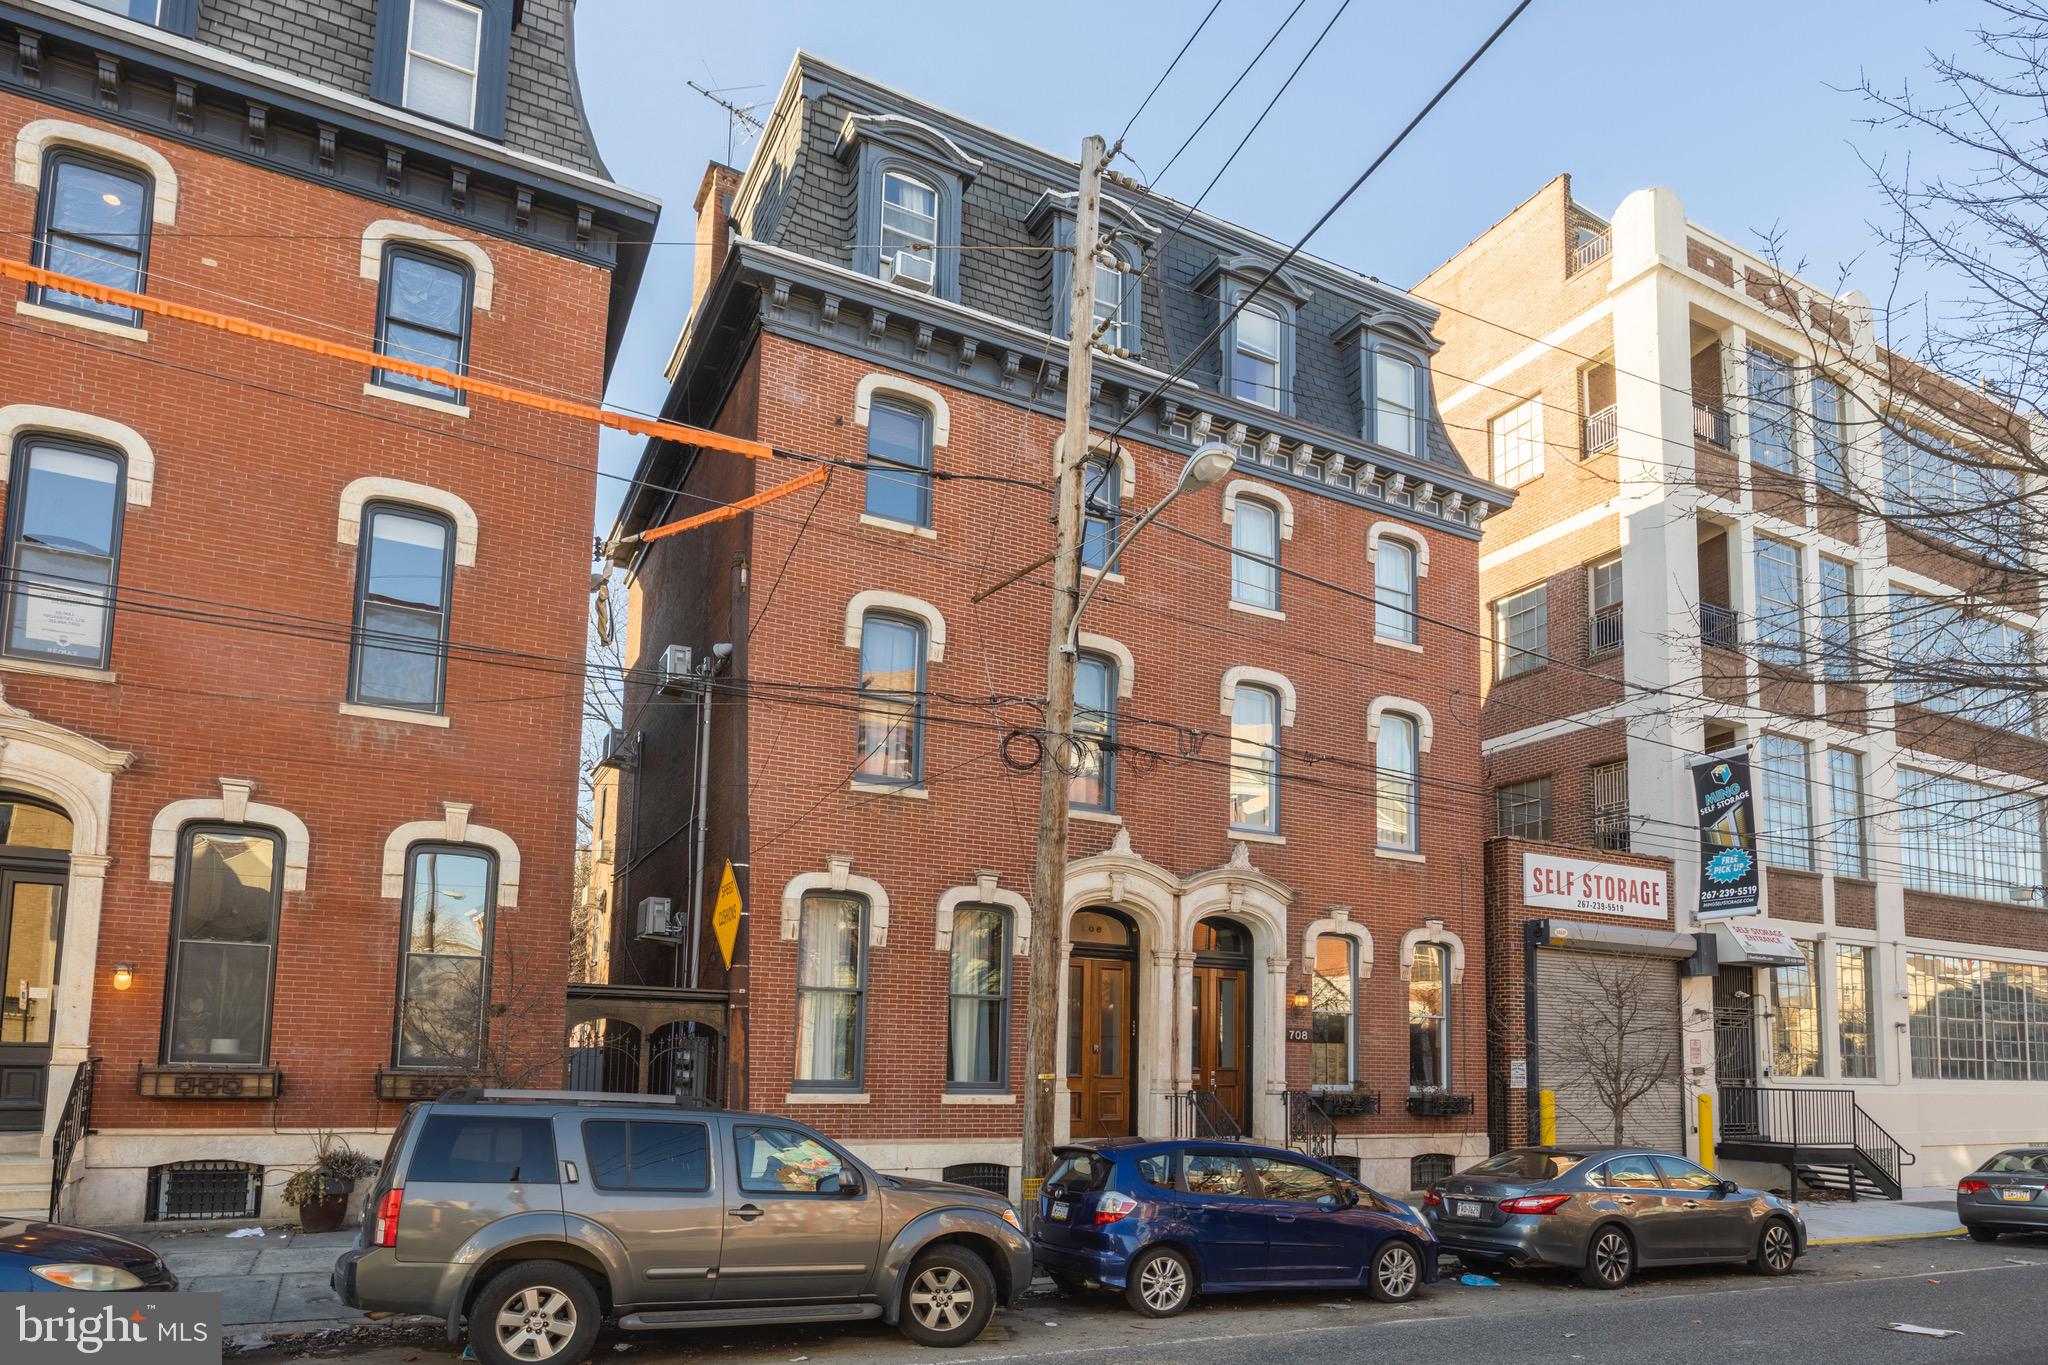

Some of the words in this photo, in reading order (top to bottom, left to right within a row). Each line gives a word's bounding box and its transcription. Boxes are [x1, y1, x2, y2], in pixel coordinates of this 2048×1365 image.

[1705, 783, 1741, 806] MING
[1700, 804, 1716, 816] SELF
[1717, 790, 1750, 809] STORAGE
[1721, 855, 1739, 865] FREE
[1713, 864, 1731, 874] PICK
[1733, 863, 1744, 872] UP
[721, 880, 734, 898] SPEED
[1532, 867, 1574, 896] SELF
[1582, 873, 1660, 906] STORAGE
[1577, 899, 1624, 913] 267-239-5519
[1732, 925, 1749, 934] SELF
[1751, 927, 1785, 938] STORAGE
[1745, 934, 1783, 944] ENTRANCE
[1289, 1030, 1308, 1040] 708
